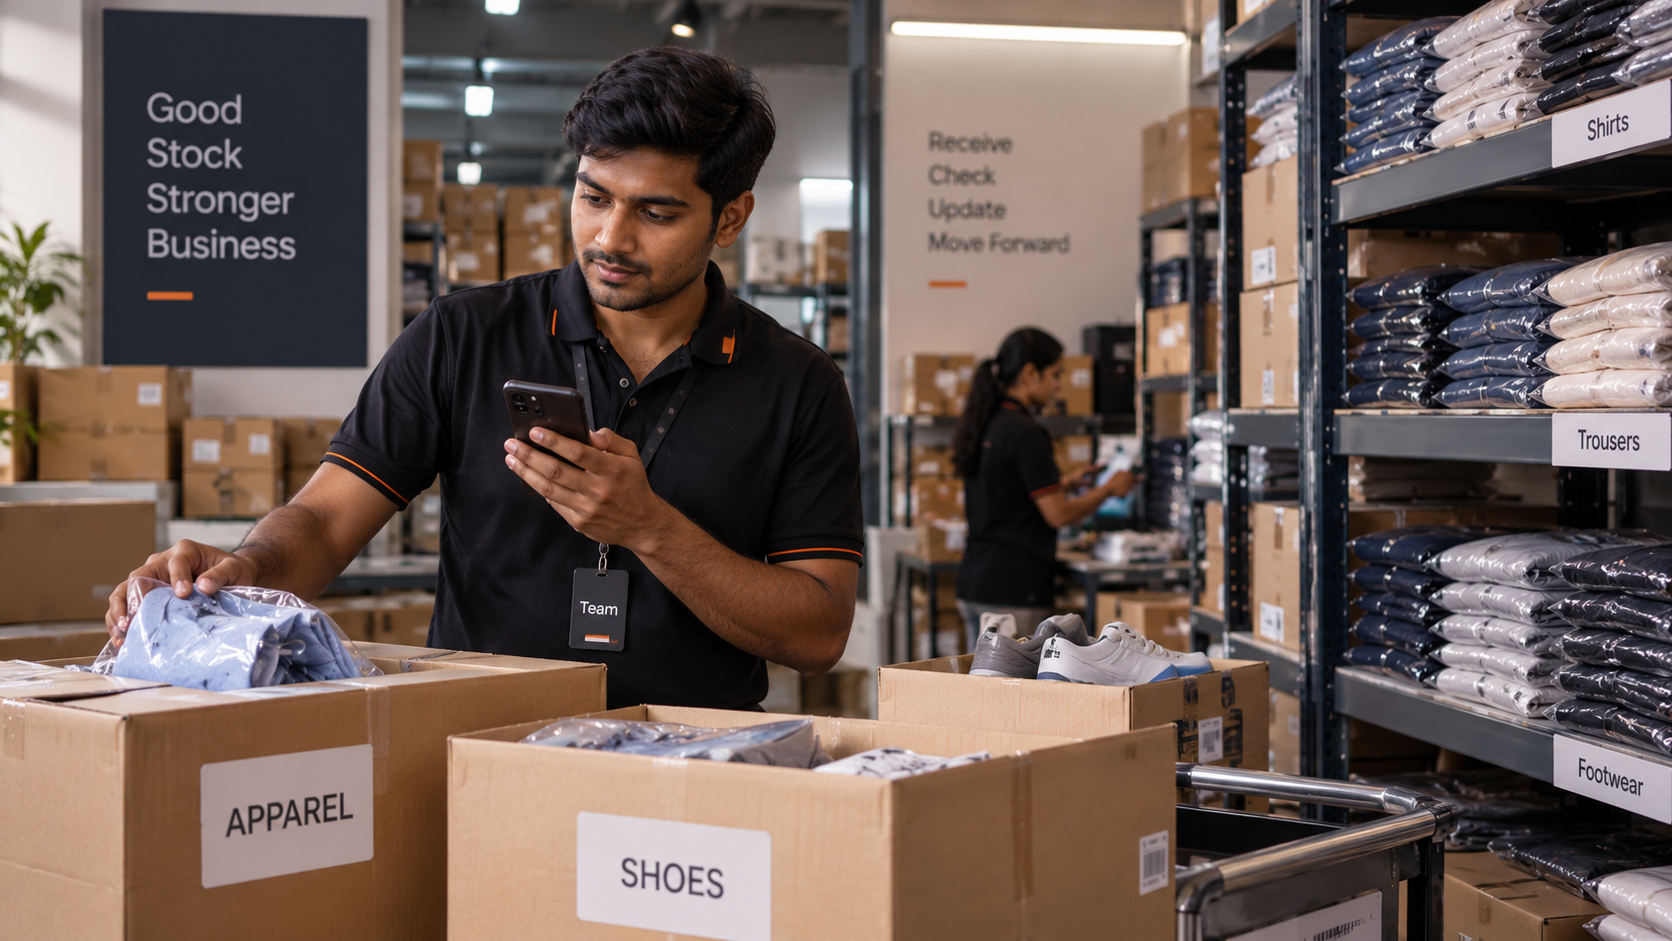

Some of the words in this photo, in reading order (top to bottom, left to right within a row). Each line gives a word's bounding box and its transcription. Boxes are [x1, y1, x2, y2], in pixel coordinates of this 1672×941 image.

[147, 93, 242, 125] Good
[929, 131, 1013, 154] Receive
[1587, 113, 1630, 142] Shirts
[147, 138, 243, 169] Stock
[929, 165, 996, 186] Check
[147, 183, 295, 222] Stronger
[929, 200, 1007, 222] Update
[147, 228, 297, 260] Business
[929, 233, 985, 252] Move
[990, 233, 1070, 254] Forward
[1577, 429, 1641, 452] Trousers
[579, 600, 618, 616] Team
[1577, 757, 1645, 798] Footwear
[225, 792, 354, 838] APPAREL
[621, 857, 724, 900] SHOES
